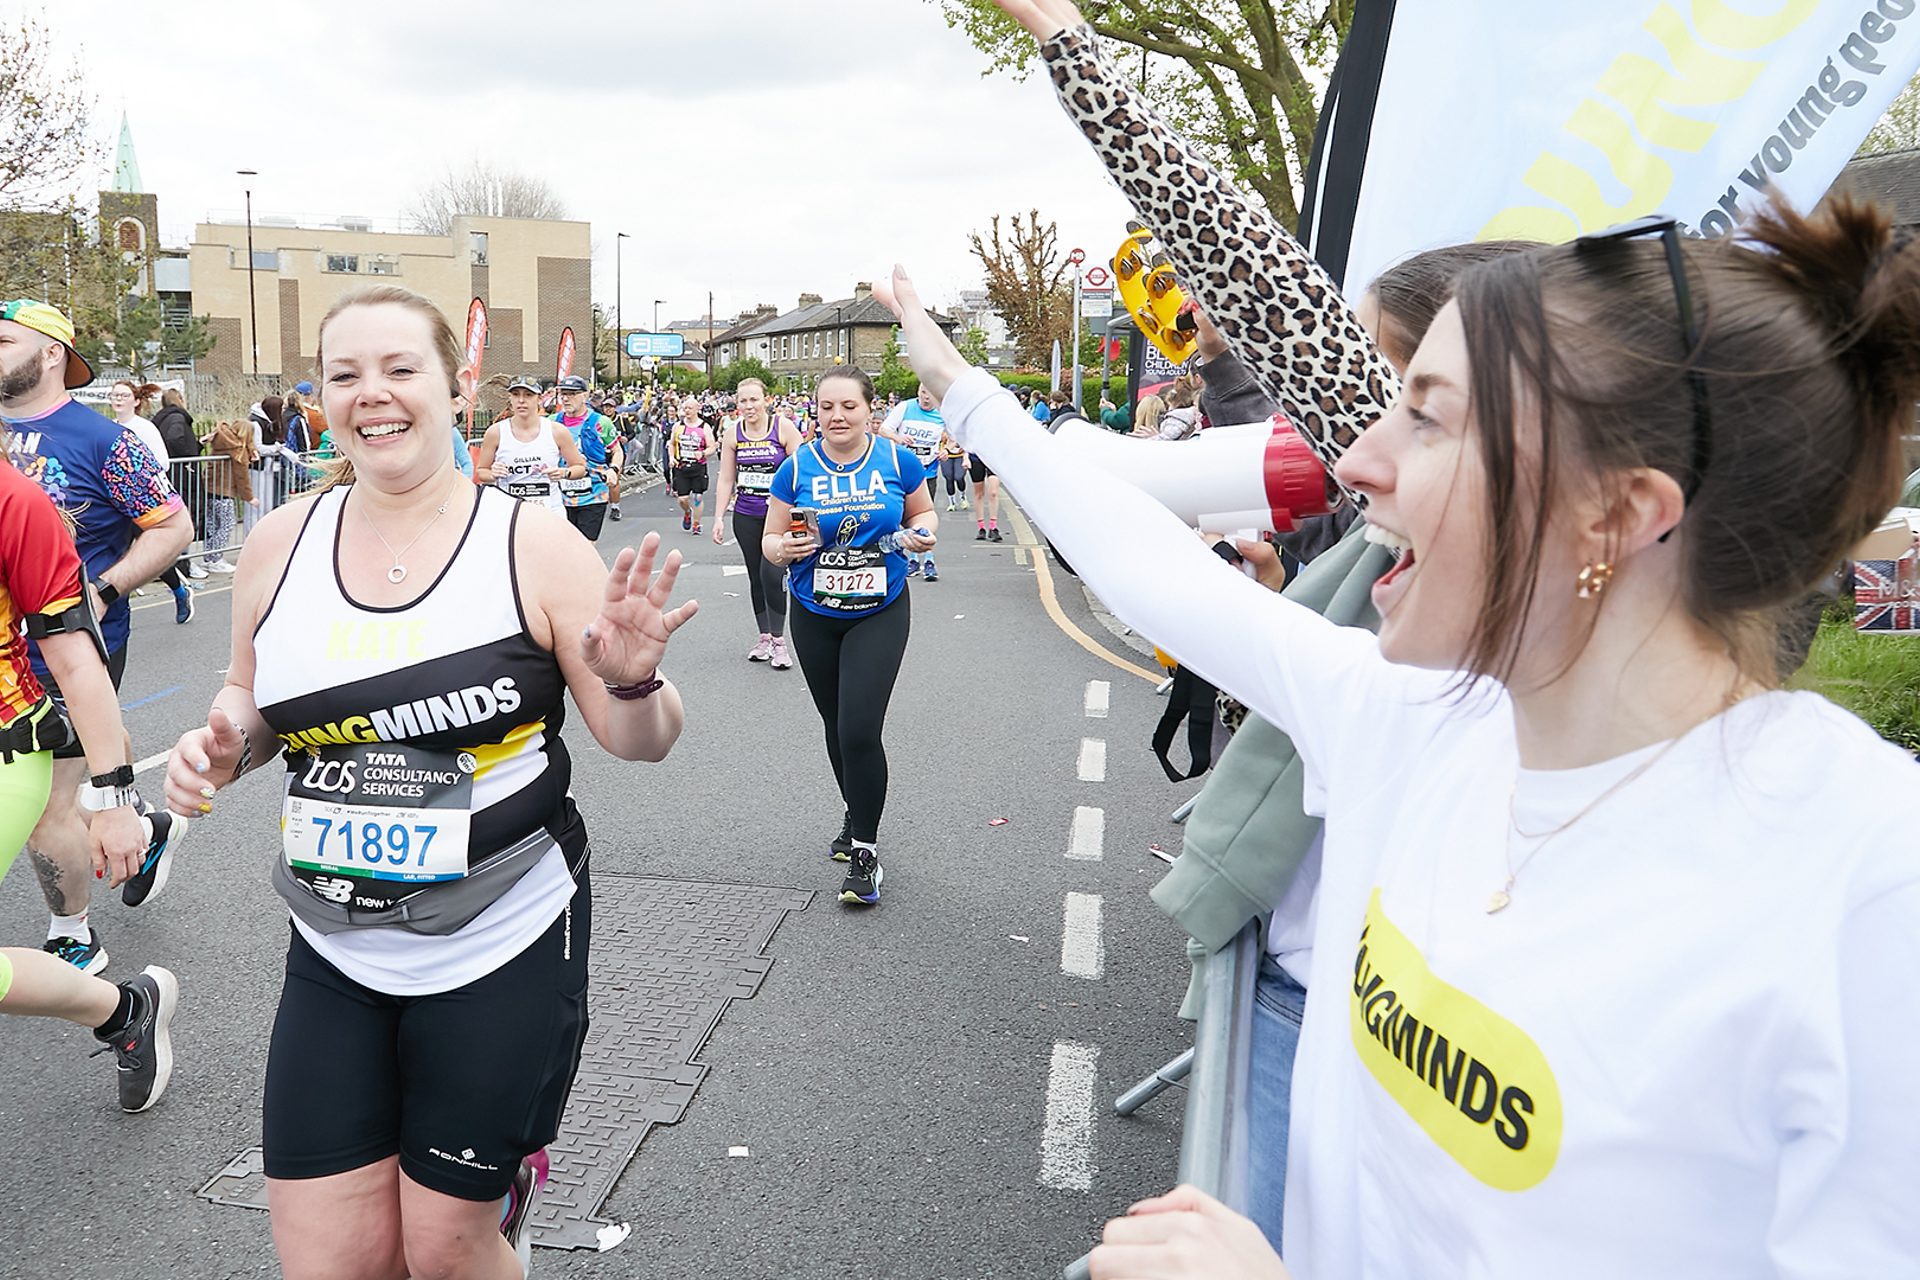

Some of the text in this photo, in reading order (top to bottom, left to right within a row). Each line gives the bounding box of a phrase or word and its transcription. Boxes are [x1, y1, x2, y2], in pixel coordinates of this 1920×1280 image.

[1146, 345, 1168, 360] BL
[903, 426, 934, 439] JDRF
[737, 441, 772, 449] MAXINE
[744, 475, 771, 484] 66744
[812, 469, 889, 501] ELLA
[820, 496, 858, 507] Children's
[844, 503, 886, 512] Foundation
[825, 573, 875, 591] 31272
[325, 620, 427, 661] KATE
[365, 752, 408, 767] TATA
[363, 767, 462, 786] CONSULTANCY
[361, 782, 425, 798] SERVICES
[312, 816, 438, 868] 71897
[355, 896, 385, 909] new
[1354, 924, 1534, 1150] UGMINDS
